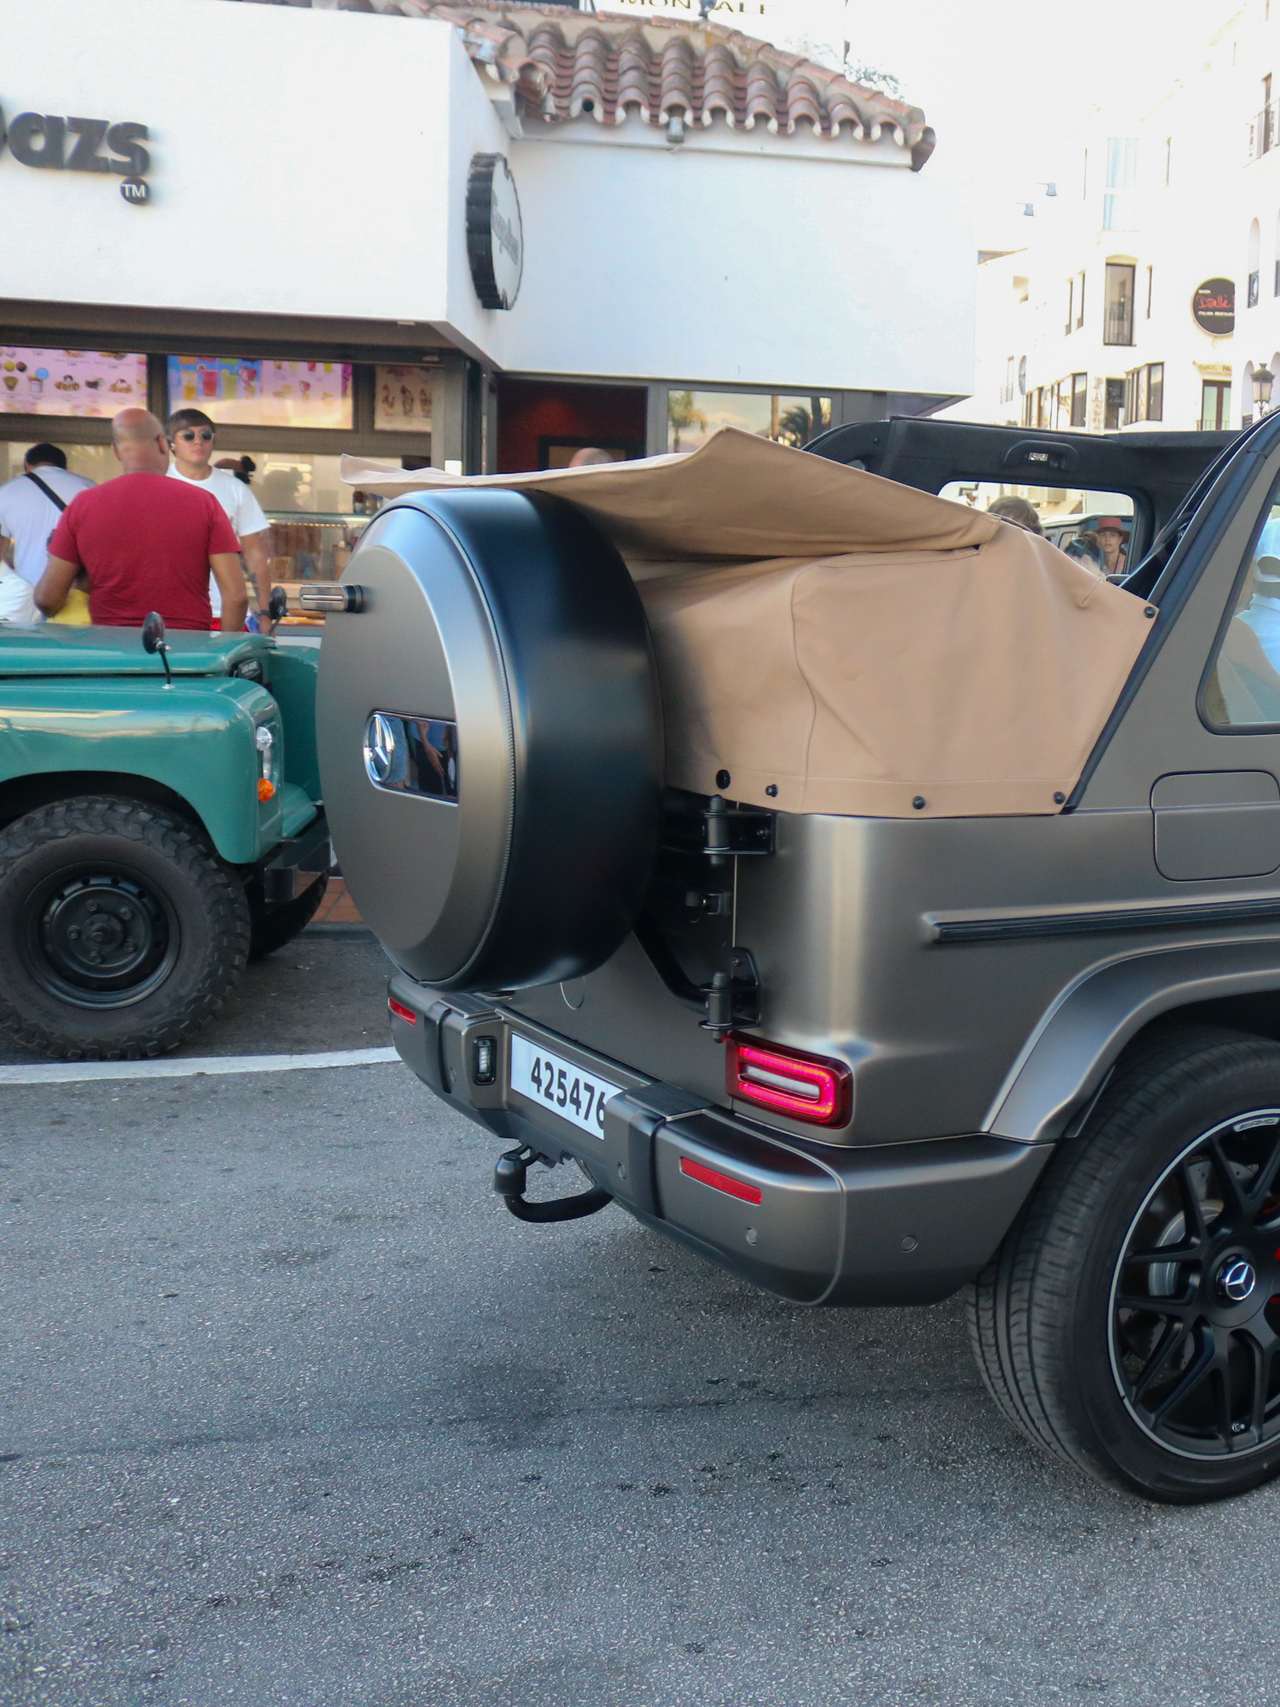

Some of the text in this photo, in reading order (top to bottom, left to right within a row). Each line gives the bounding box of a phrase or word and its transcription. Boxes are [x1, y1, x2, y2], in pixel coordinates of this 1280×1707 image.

[0, 103, 150, 176] azs
[121, 183, 146, 197] TM
[531, 1056, 606, 1130] 425476
